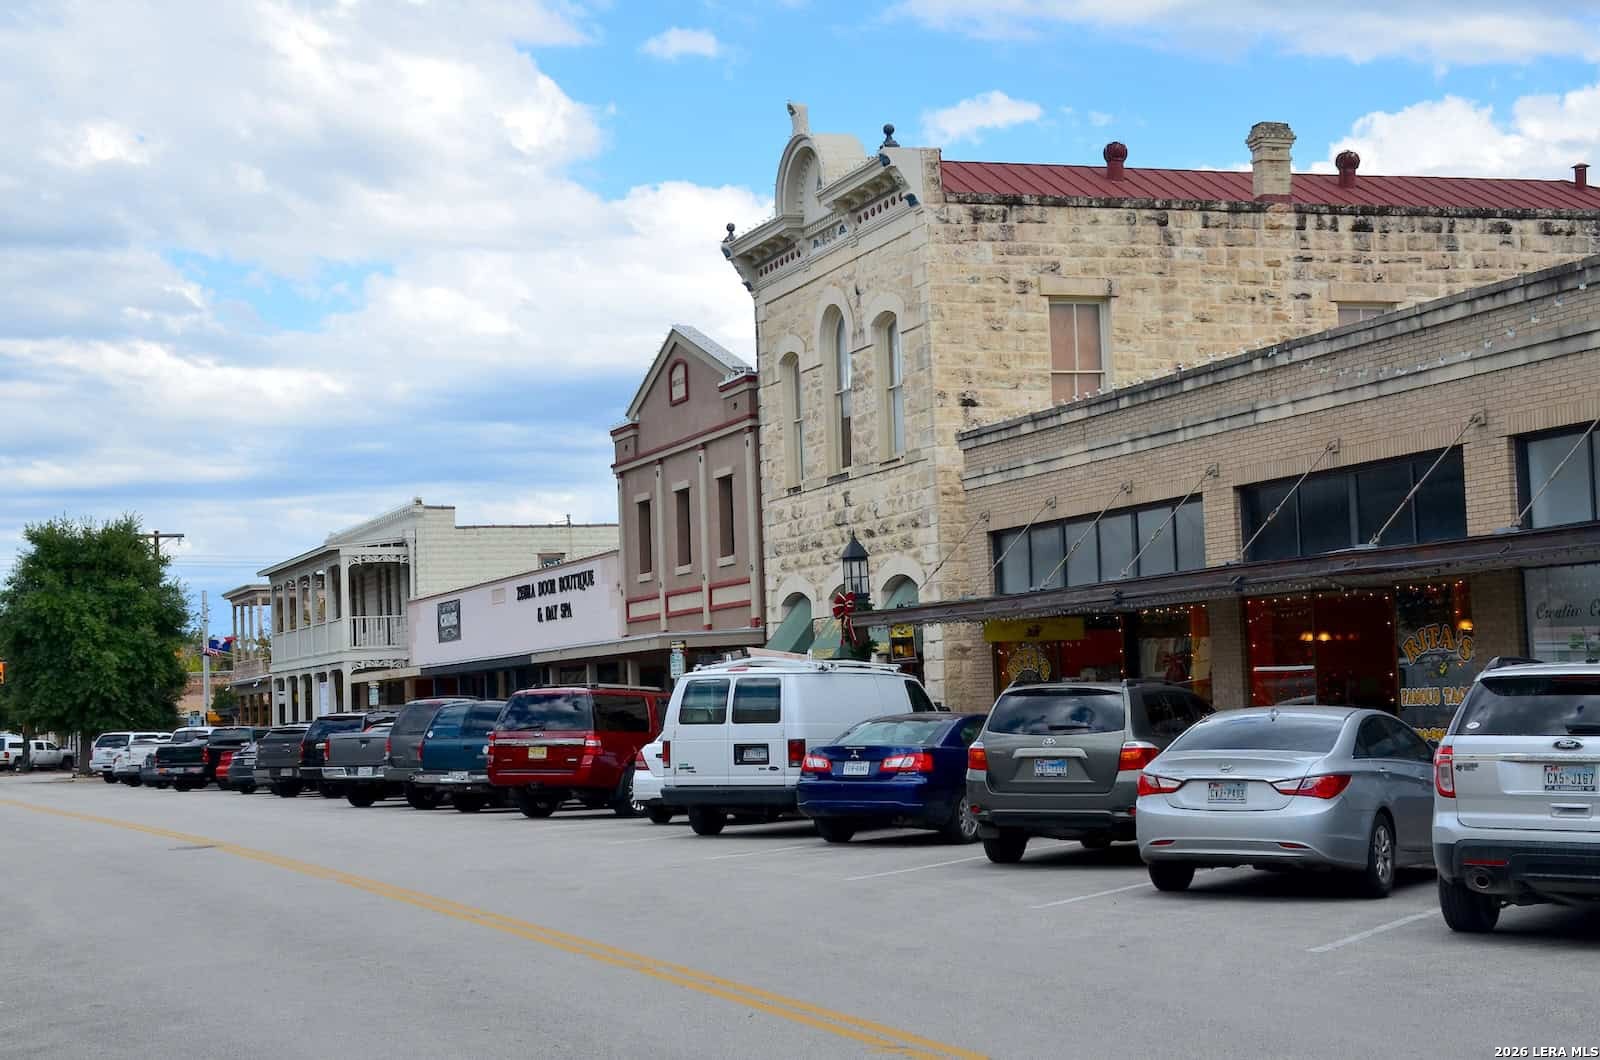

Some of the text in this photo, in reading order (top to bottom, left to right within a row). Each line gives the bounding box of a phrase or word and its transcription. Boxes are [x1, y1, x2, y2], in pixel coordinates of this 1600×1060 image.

[516, 569, 595, 601] ZEBRA DOOR BOUTIQUE
[545, 604, 558, 621] DAY
[560, 601, 572, 618] SPA
[1401, 623, 1473, 665] RITA'S
